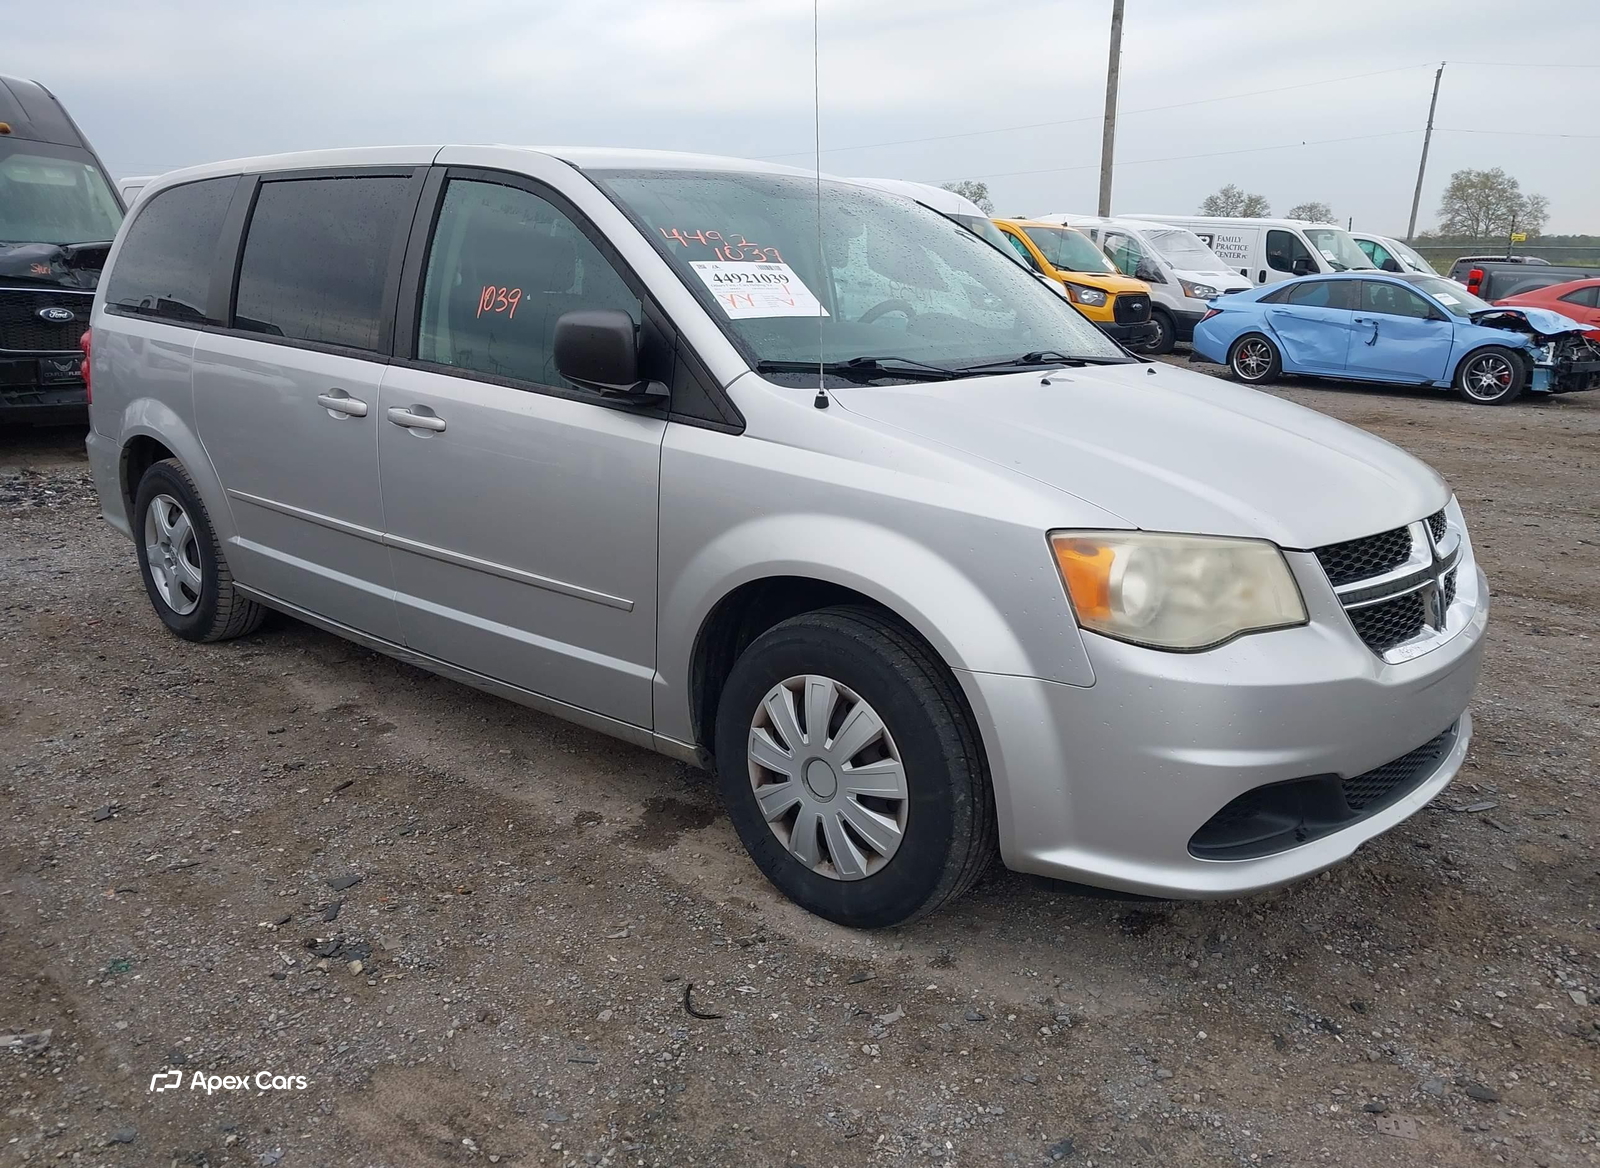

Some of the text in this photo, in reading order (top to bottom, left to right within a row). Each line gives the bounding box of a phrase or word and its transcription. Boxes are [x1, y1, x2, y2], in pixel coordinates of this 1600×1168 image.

[660, 227, 757, 247] 4492
[1217, 234, 1242, 243] FAMILY
[1216, 243, 1248, 251] PRACTICE
[715, 245, 784, 263] 1039
[1215, 250, 1241, 259] CENTER
[713, 272, 790, 284] 44921039
[476, 285, 522, 319] 1039
